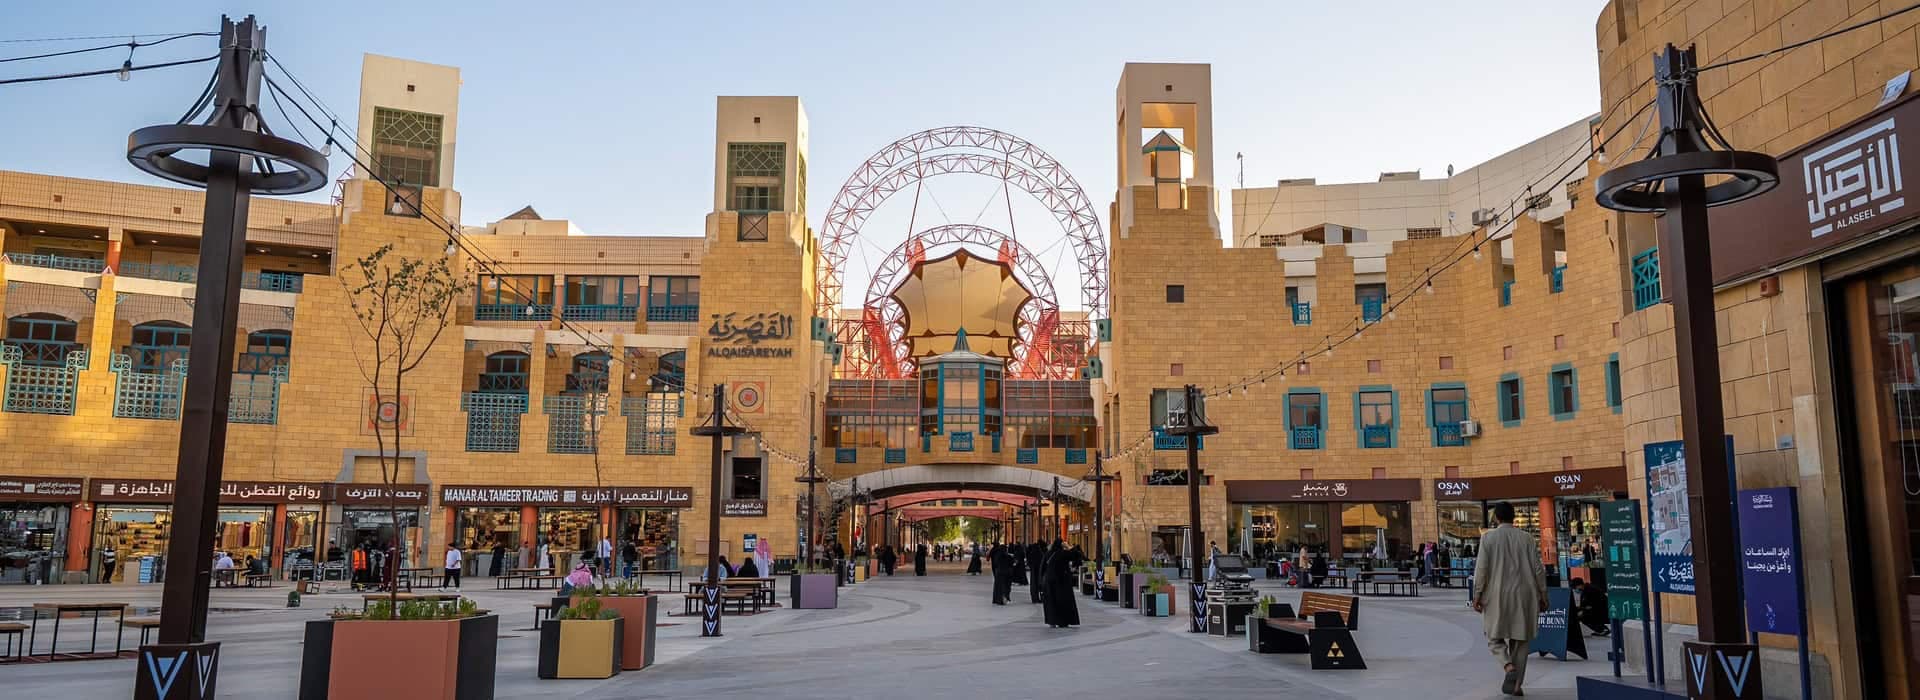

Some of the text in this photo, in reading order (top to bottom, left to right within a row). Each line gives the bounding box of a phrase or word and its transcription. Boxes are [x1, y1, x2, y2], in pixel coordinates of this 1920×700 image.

[708, 347, 793, 358] ALQAISAREYAH
[1554, 474, 1581, 484] OSAN
[119, 482, 172, 496] الجاهزة
[239, 485, 286, 498] القطن
[288, 485, 322, 500] روائع
[1438, 482, 1470, 490] OSAN
[444, 489, 559, 502] MANAR AL TAMEER TRADING
[619, 489, 662, 503] التعمير
[663, 489, 688, 504] منار
[1745, 547, 1777, 556] الساعات
